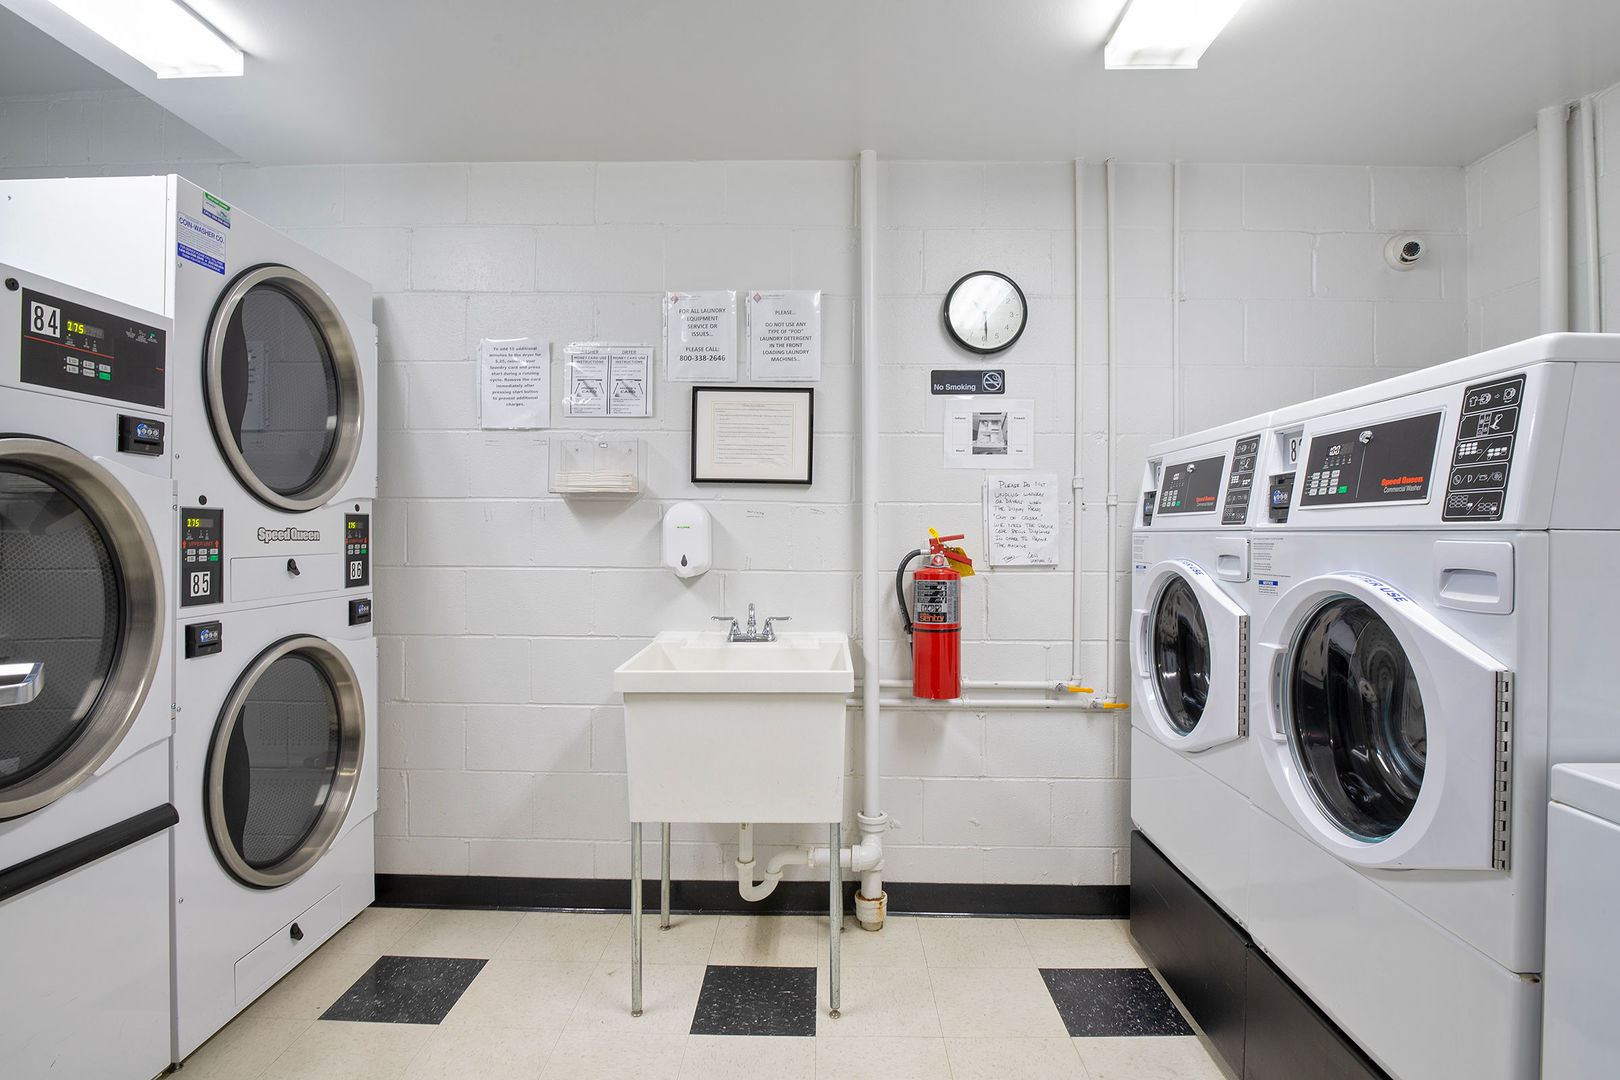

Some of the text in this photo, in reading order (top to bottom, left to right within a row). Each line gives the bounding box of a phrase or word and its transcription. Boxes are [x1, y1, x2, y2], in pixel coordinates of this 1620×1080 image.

[34, 305, 58, 335] 84
[1382, 477, 1401, 486] Speed
[257, 527, 320, 543] Speed Queen
[352, 563, 361, 578] 86
[193, 573, 209, 594] 85
[1380, 588, 1408, 602] USE
